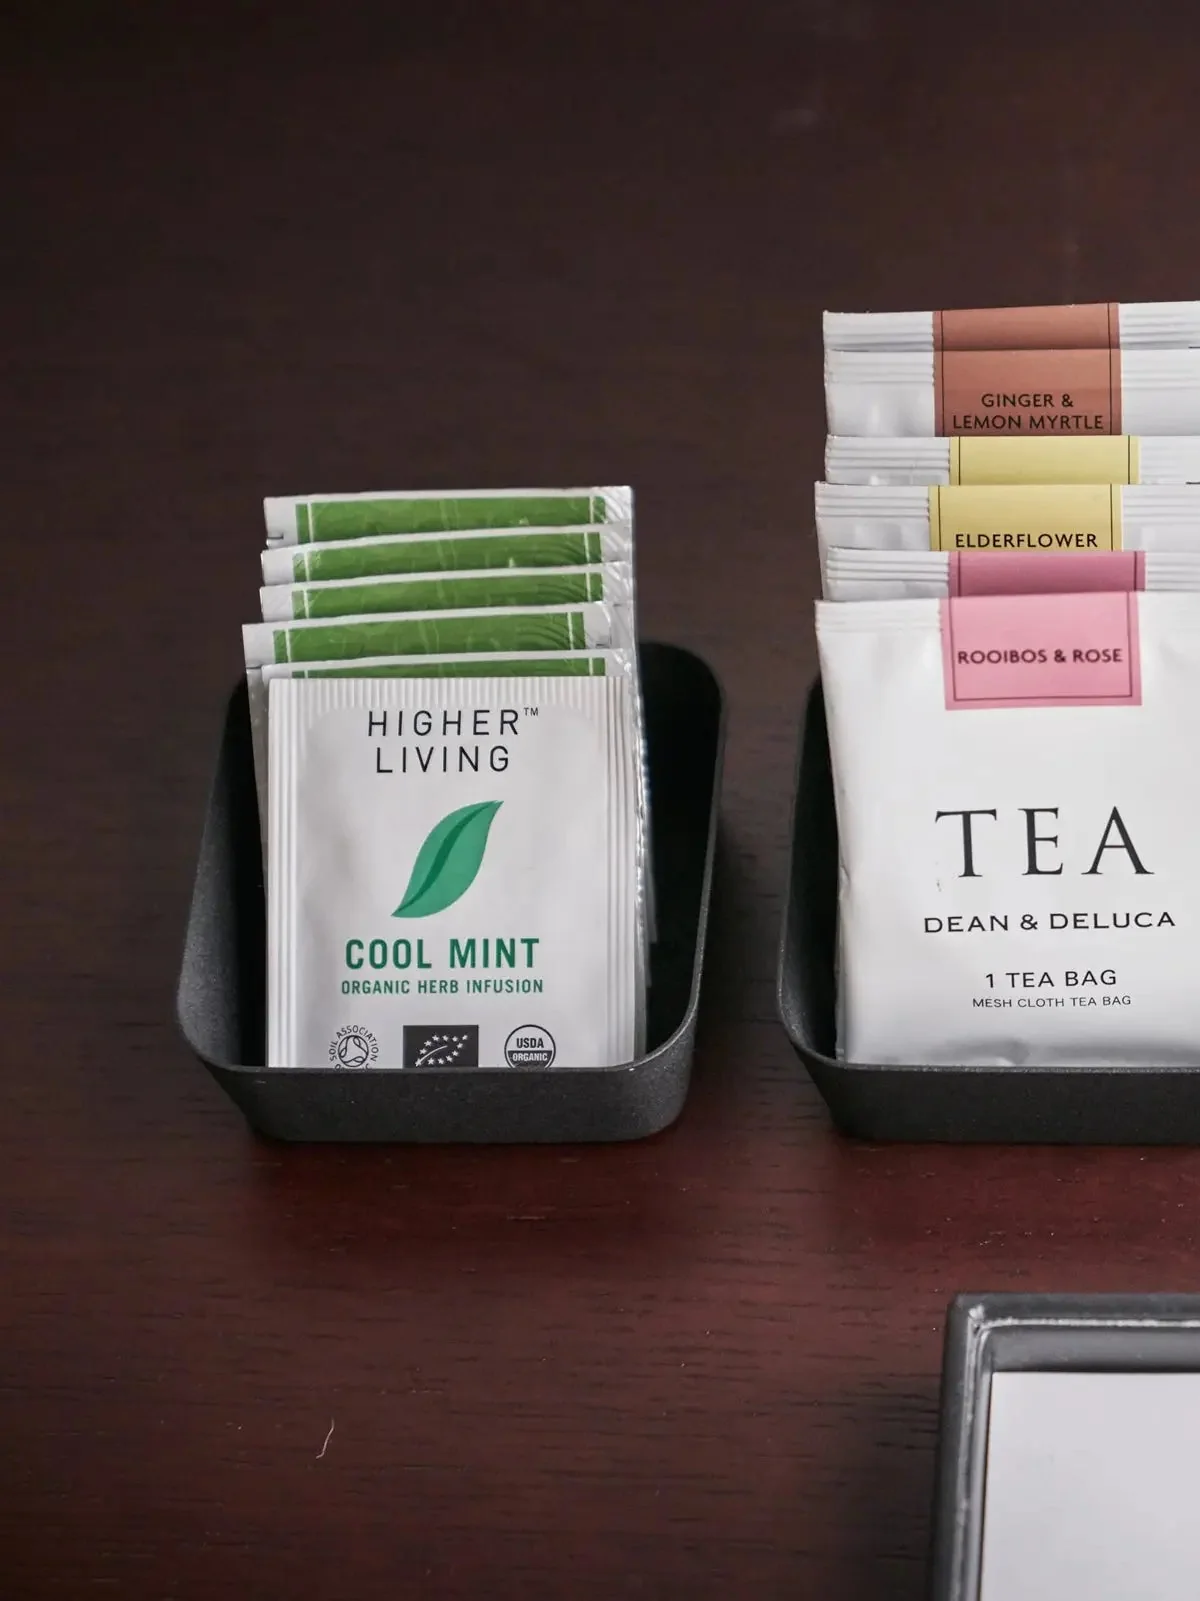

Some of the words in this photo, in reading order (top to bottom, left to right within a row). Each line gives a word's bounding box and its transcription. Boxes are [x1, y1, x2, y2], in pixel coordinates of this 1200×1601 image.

[980, 393, 1055, 408] GINGER
[1061, 393, 1074, 408] &
[952, 414, 1022, 430] LEMON
[1029, 414, 1104, 431] MYRTLE
[955, 533, 1099, 549] ELDERFLOWER
[957, 648, 1048, 665] ROOIBOS
[1053, 648, 1067, 664] &
[1072, 648, 1123, 664] ROSE
[368, 709, 519, 737] HIGHER
[376, 745, 509, 774] LIVING
[934, 805, 1155, 878] TEA
[923, 914, 1009, 934] DEAN
[1019, 913, 1038, 931] &
[1049, 911, 1176, 930] DELUCA
[345, 938, 433, 970] COOL
[449, 937, 540, 969] MINT
[341, 979, 410, 995] ORGANIC
[417, 979, 459, 994] HERB
[466, 978, 543, 994] INFUSION
[985, 973, 994, 989] 1
[1005, 971, 1055, 989] TEA
[1064, 969, 1117, 987] BAG
[972, 998, 1013, 1008] MESH
[1017, 997, 1065, 1008] CLOTH
[1069, 996, 1097, 1007] TEA
[1102, 995, 1131, 1006] BAG
[328, 1040, 339, 1062] SOIL
[336, 1025, 379, 1062] ASSOCIATION
[516, 1037, 545, 1049] USDA
[513, 1053, 548, 1061] ORGANIC
